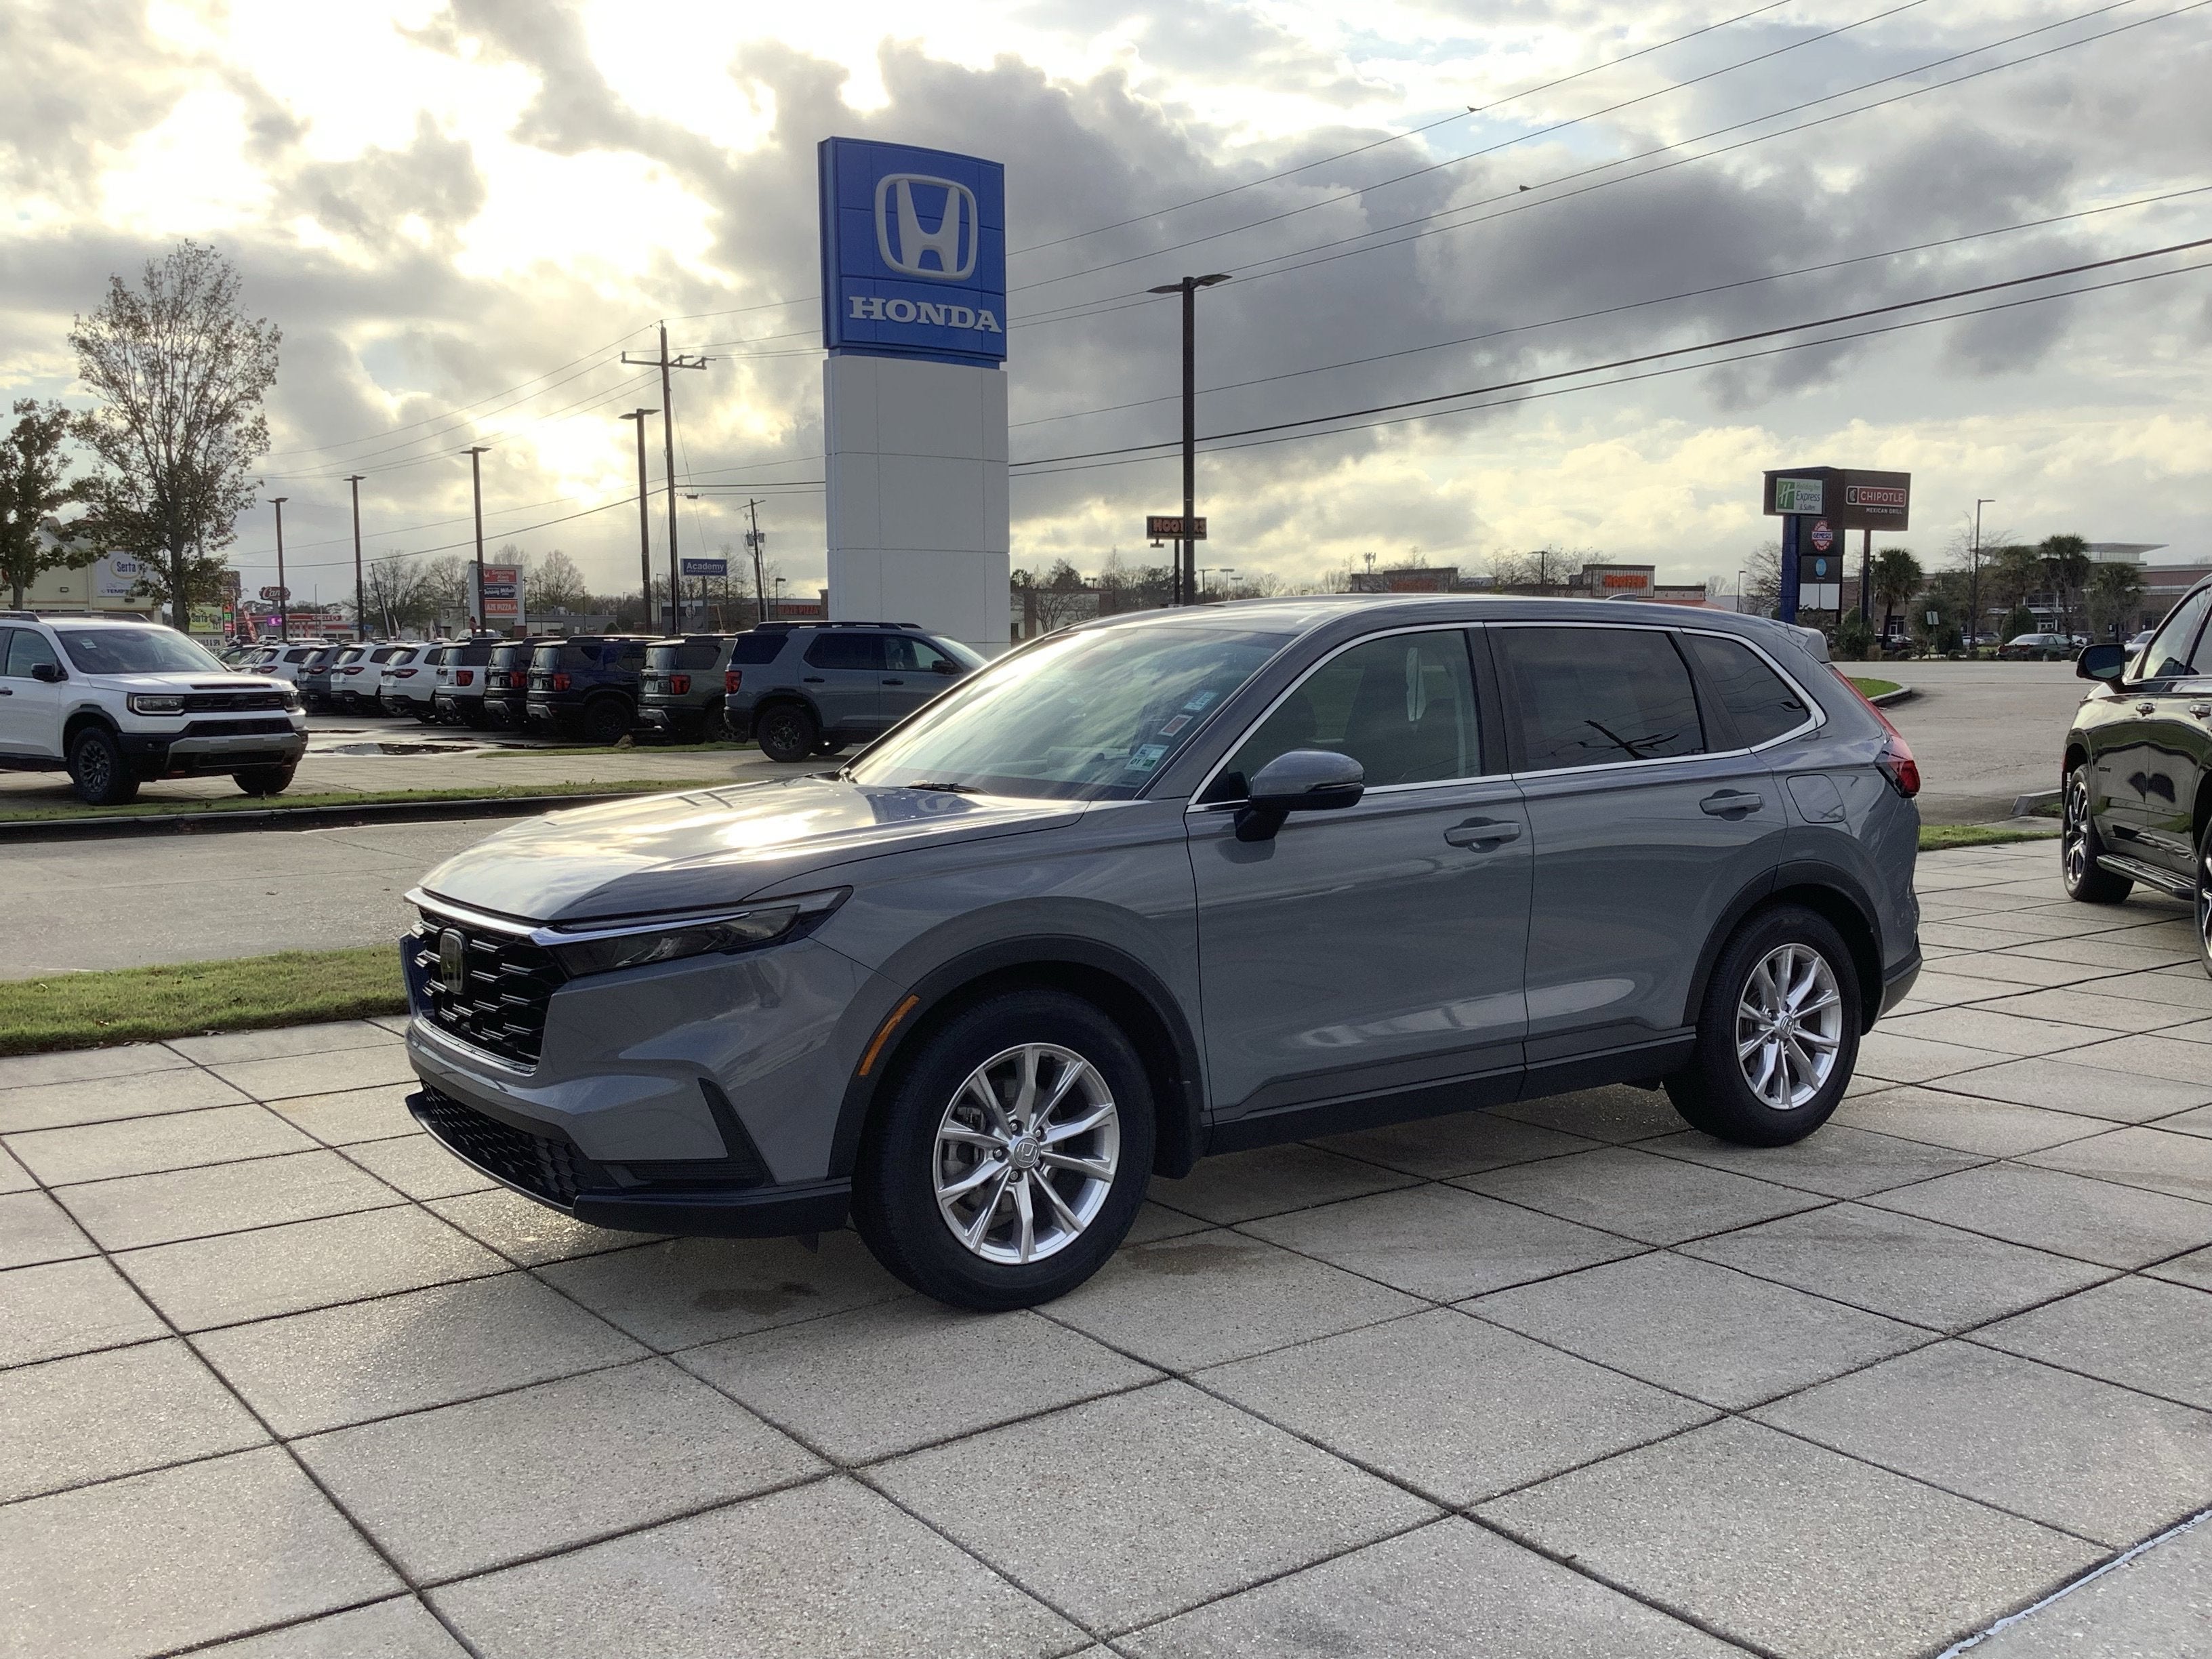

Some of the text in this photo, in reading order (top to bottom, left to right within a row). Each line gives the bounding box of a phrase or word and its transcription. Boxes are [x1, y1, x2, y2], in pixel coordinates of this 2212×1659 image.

[848, 295, 1002, 333] HONDA
[1796, 490, 1820, 503] Express
[1860, 491, 1904, 503] CHIPOTLE
[1153, 518, 1206, 533] HOOTRS
[117, 561, 136, 573] Serta
[686, 562, 724, 572] Academy
[497, 603, 512, 611] PIZZA
